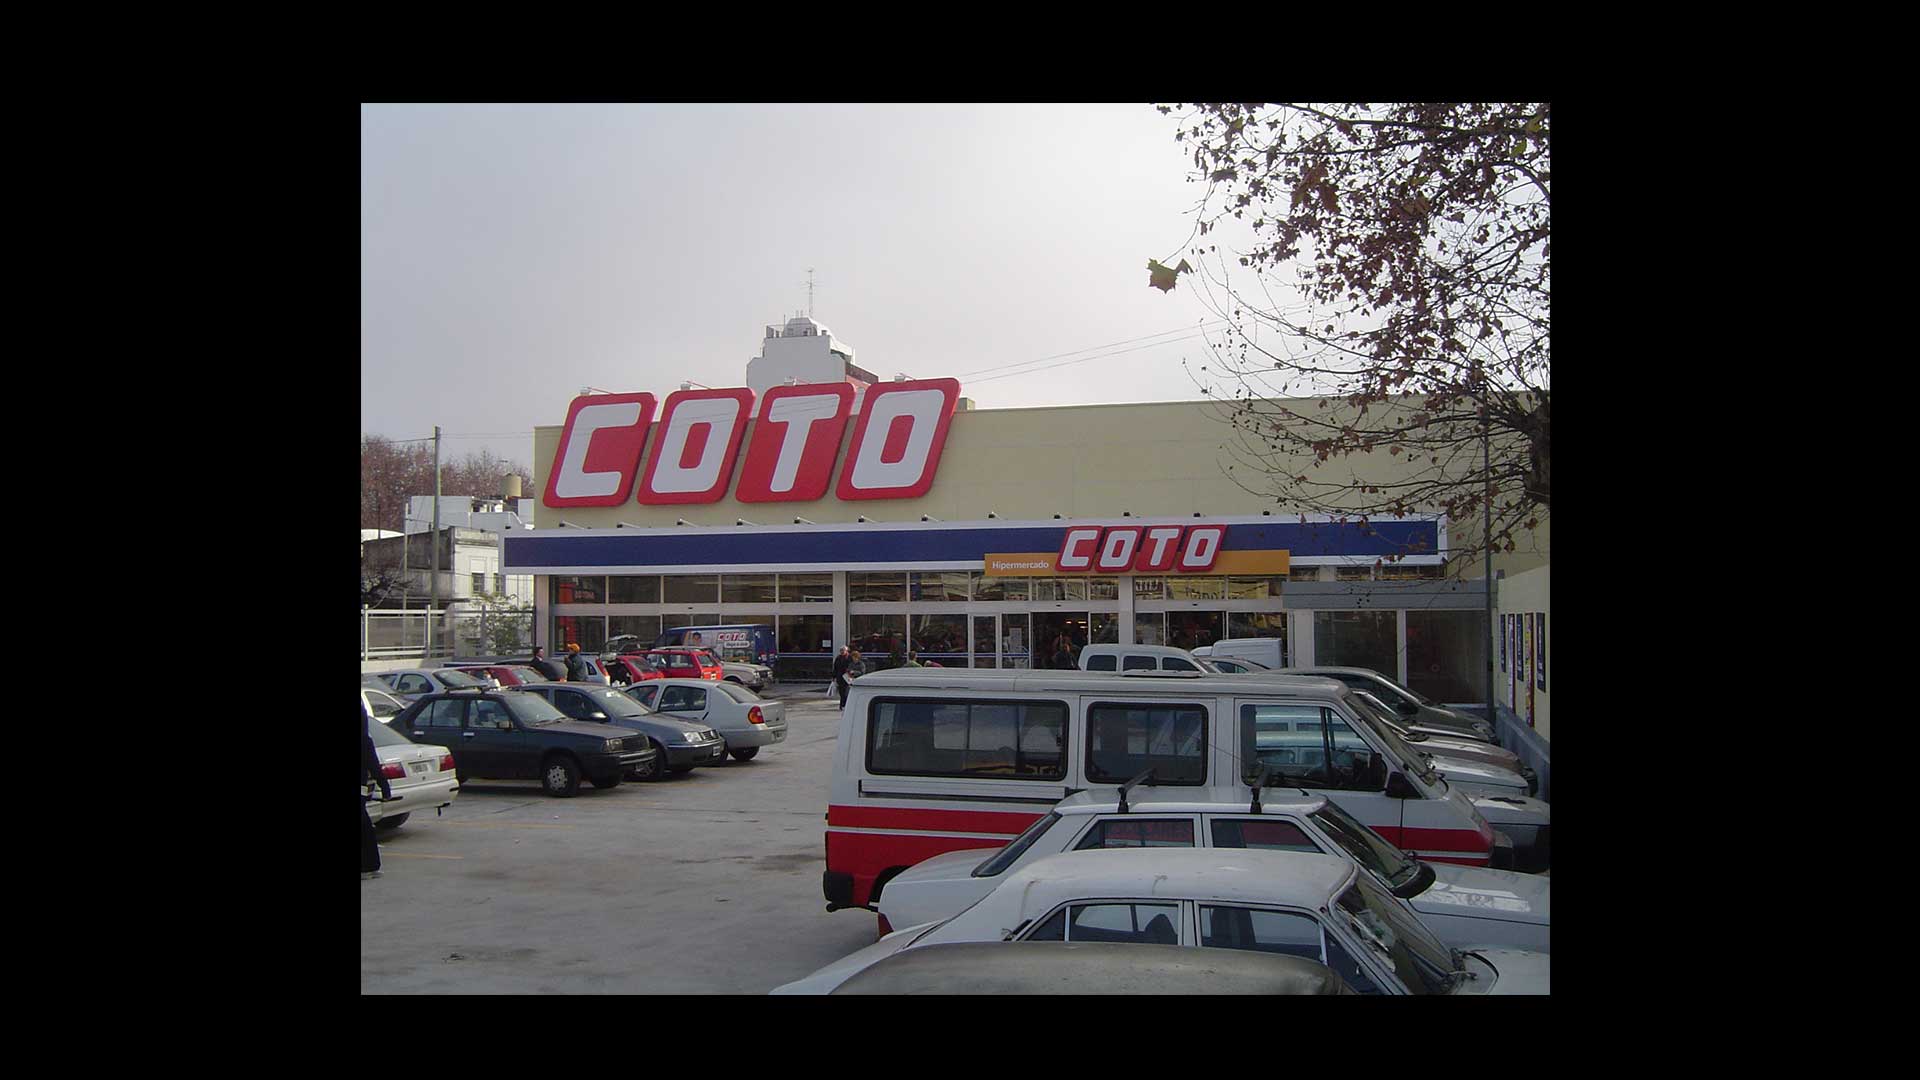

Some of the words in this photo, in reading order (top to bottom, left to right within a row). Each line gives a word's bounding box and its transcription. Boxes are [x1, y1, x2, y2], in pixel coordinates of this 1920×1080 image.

[555, 389, 946, 498] COTO
[992, 560, 1049, 570] Hipermercado
[1060, 528, 1221, 567] COTO
[718, 632, 748, 641] COTO
